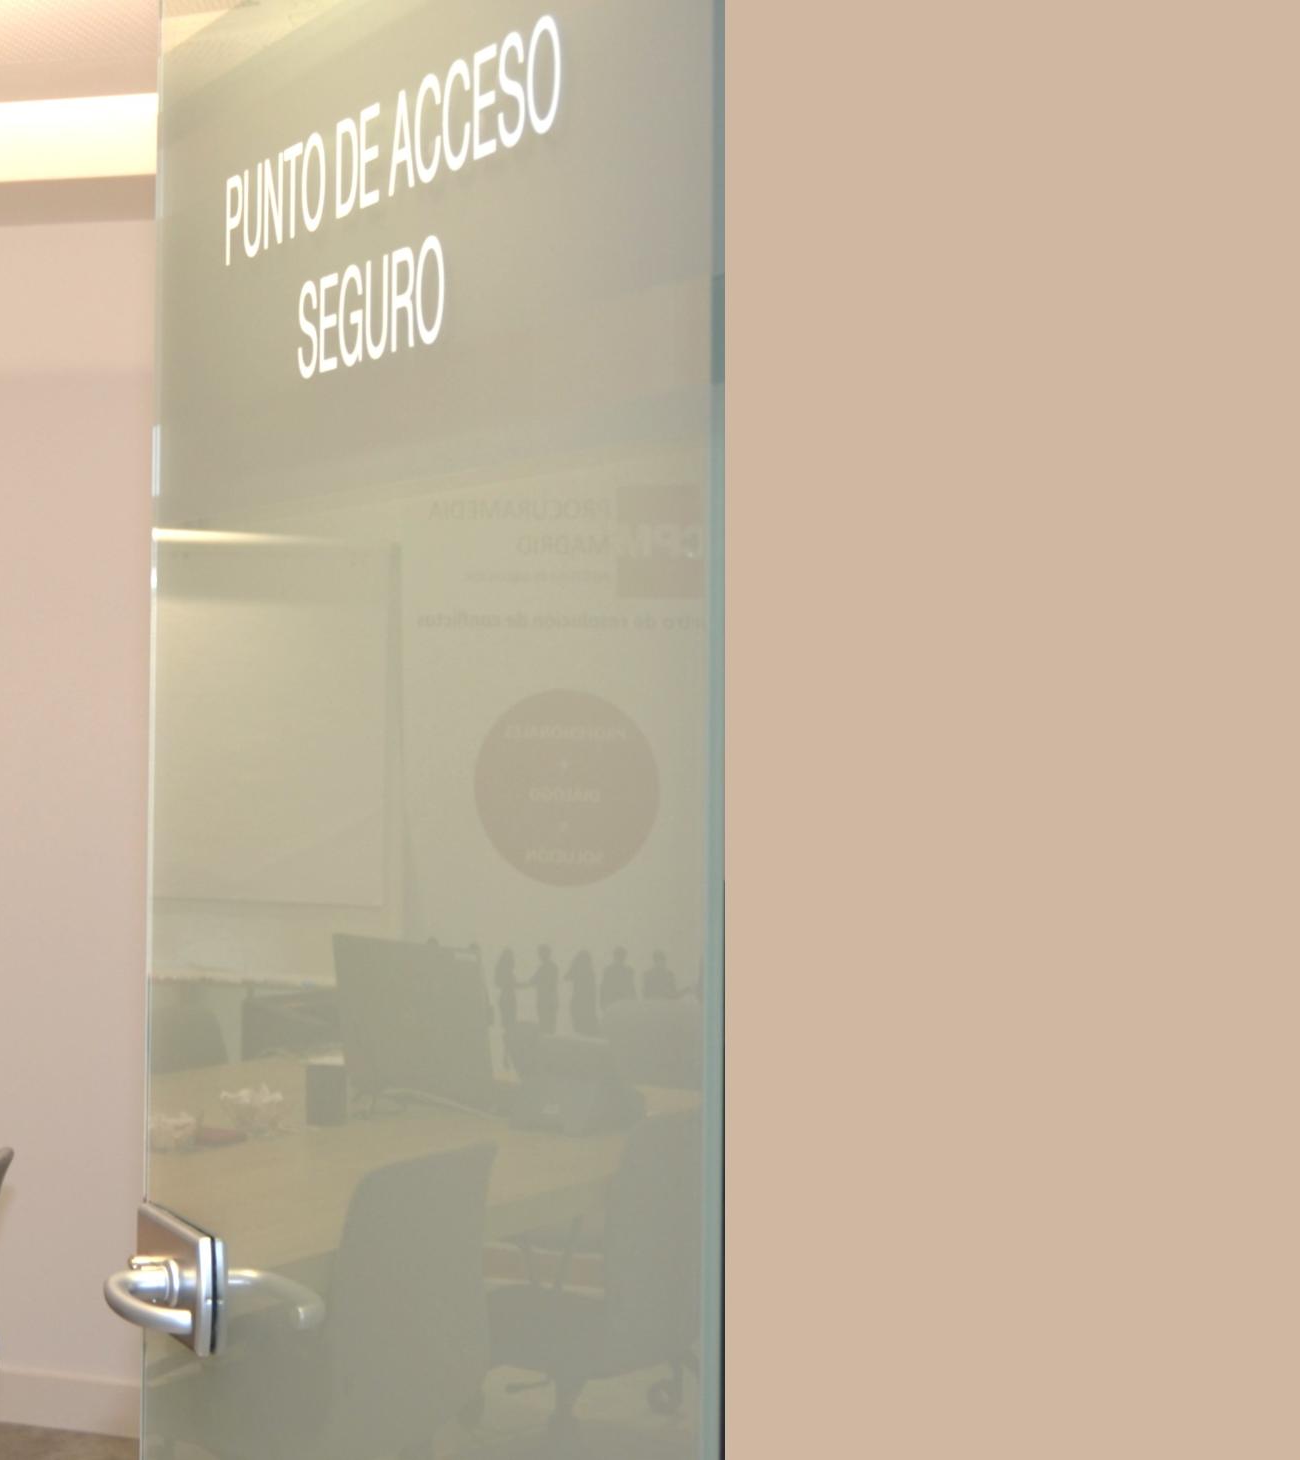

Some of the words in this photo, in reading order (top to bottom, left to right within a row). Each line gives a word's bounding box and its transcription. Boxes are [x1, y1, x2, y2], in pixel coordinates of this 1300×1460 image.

[225, 132, 327, 266] PUNTO
[335, 102, 380, 219] DE
[388, 15, 561, 196] ACCESO
[298, 235, 445, 379] SEGURO
